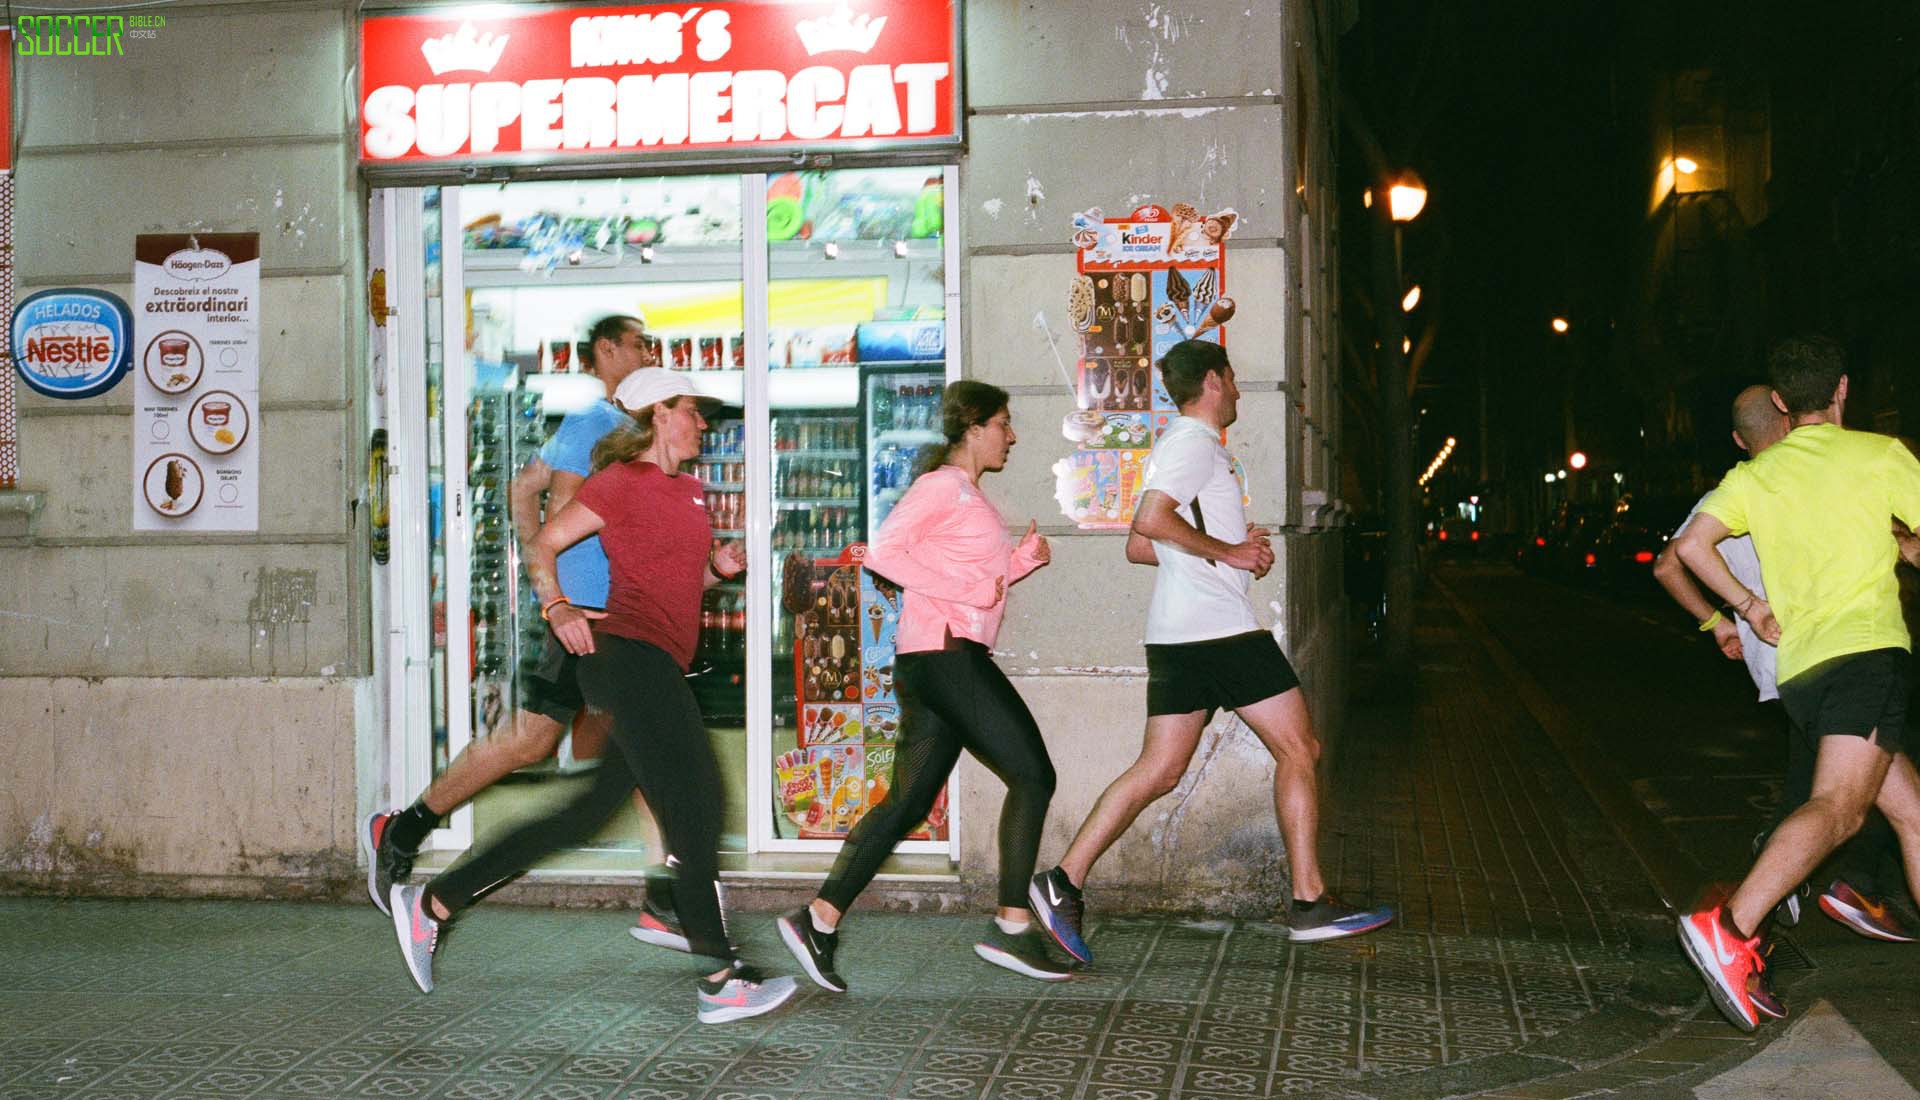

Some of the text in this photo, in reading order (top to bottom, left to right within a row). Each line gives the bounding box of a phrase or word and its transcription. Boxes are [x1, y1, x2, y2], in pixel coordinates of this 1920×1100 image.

[364, 62, 949, 159] SUPERMERCAT
[1122, 232, 1163, 244] Kinder
[154, 286, 239, 296] Descobreix el nostre
[34, 303, 102, 320] HELADOS
[145, 297, 248, 313] exträordinari
